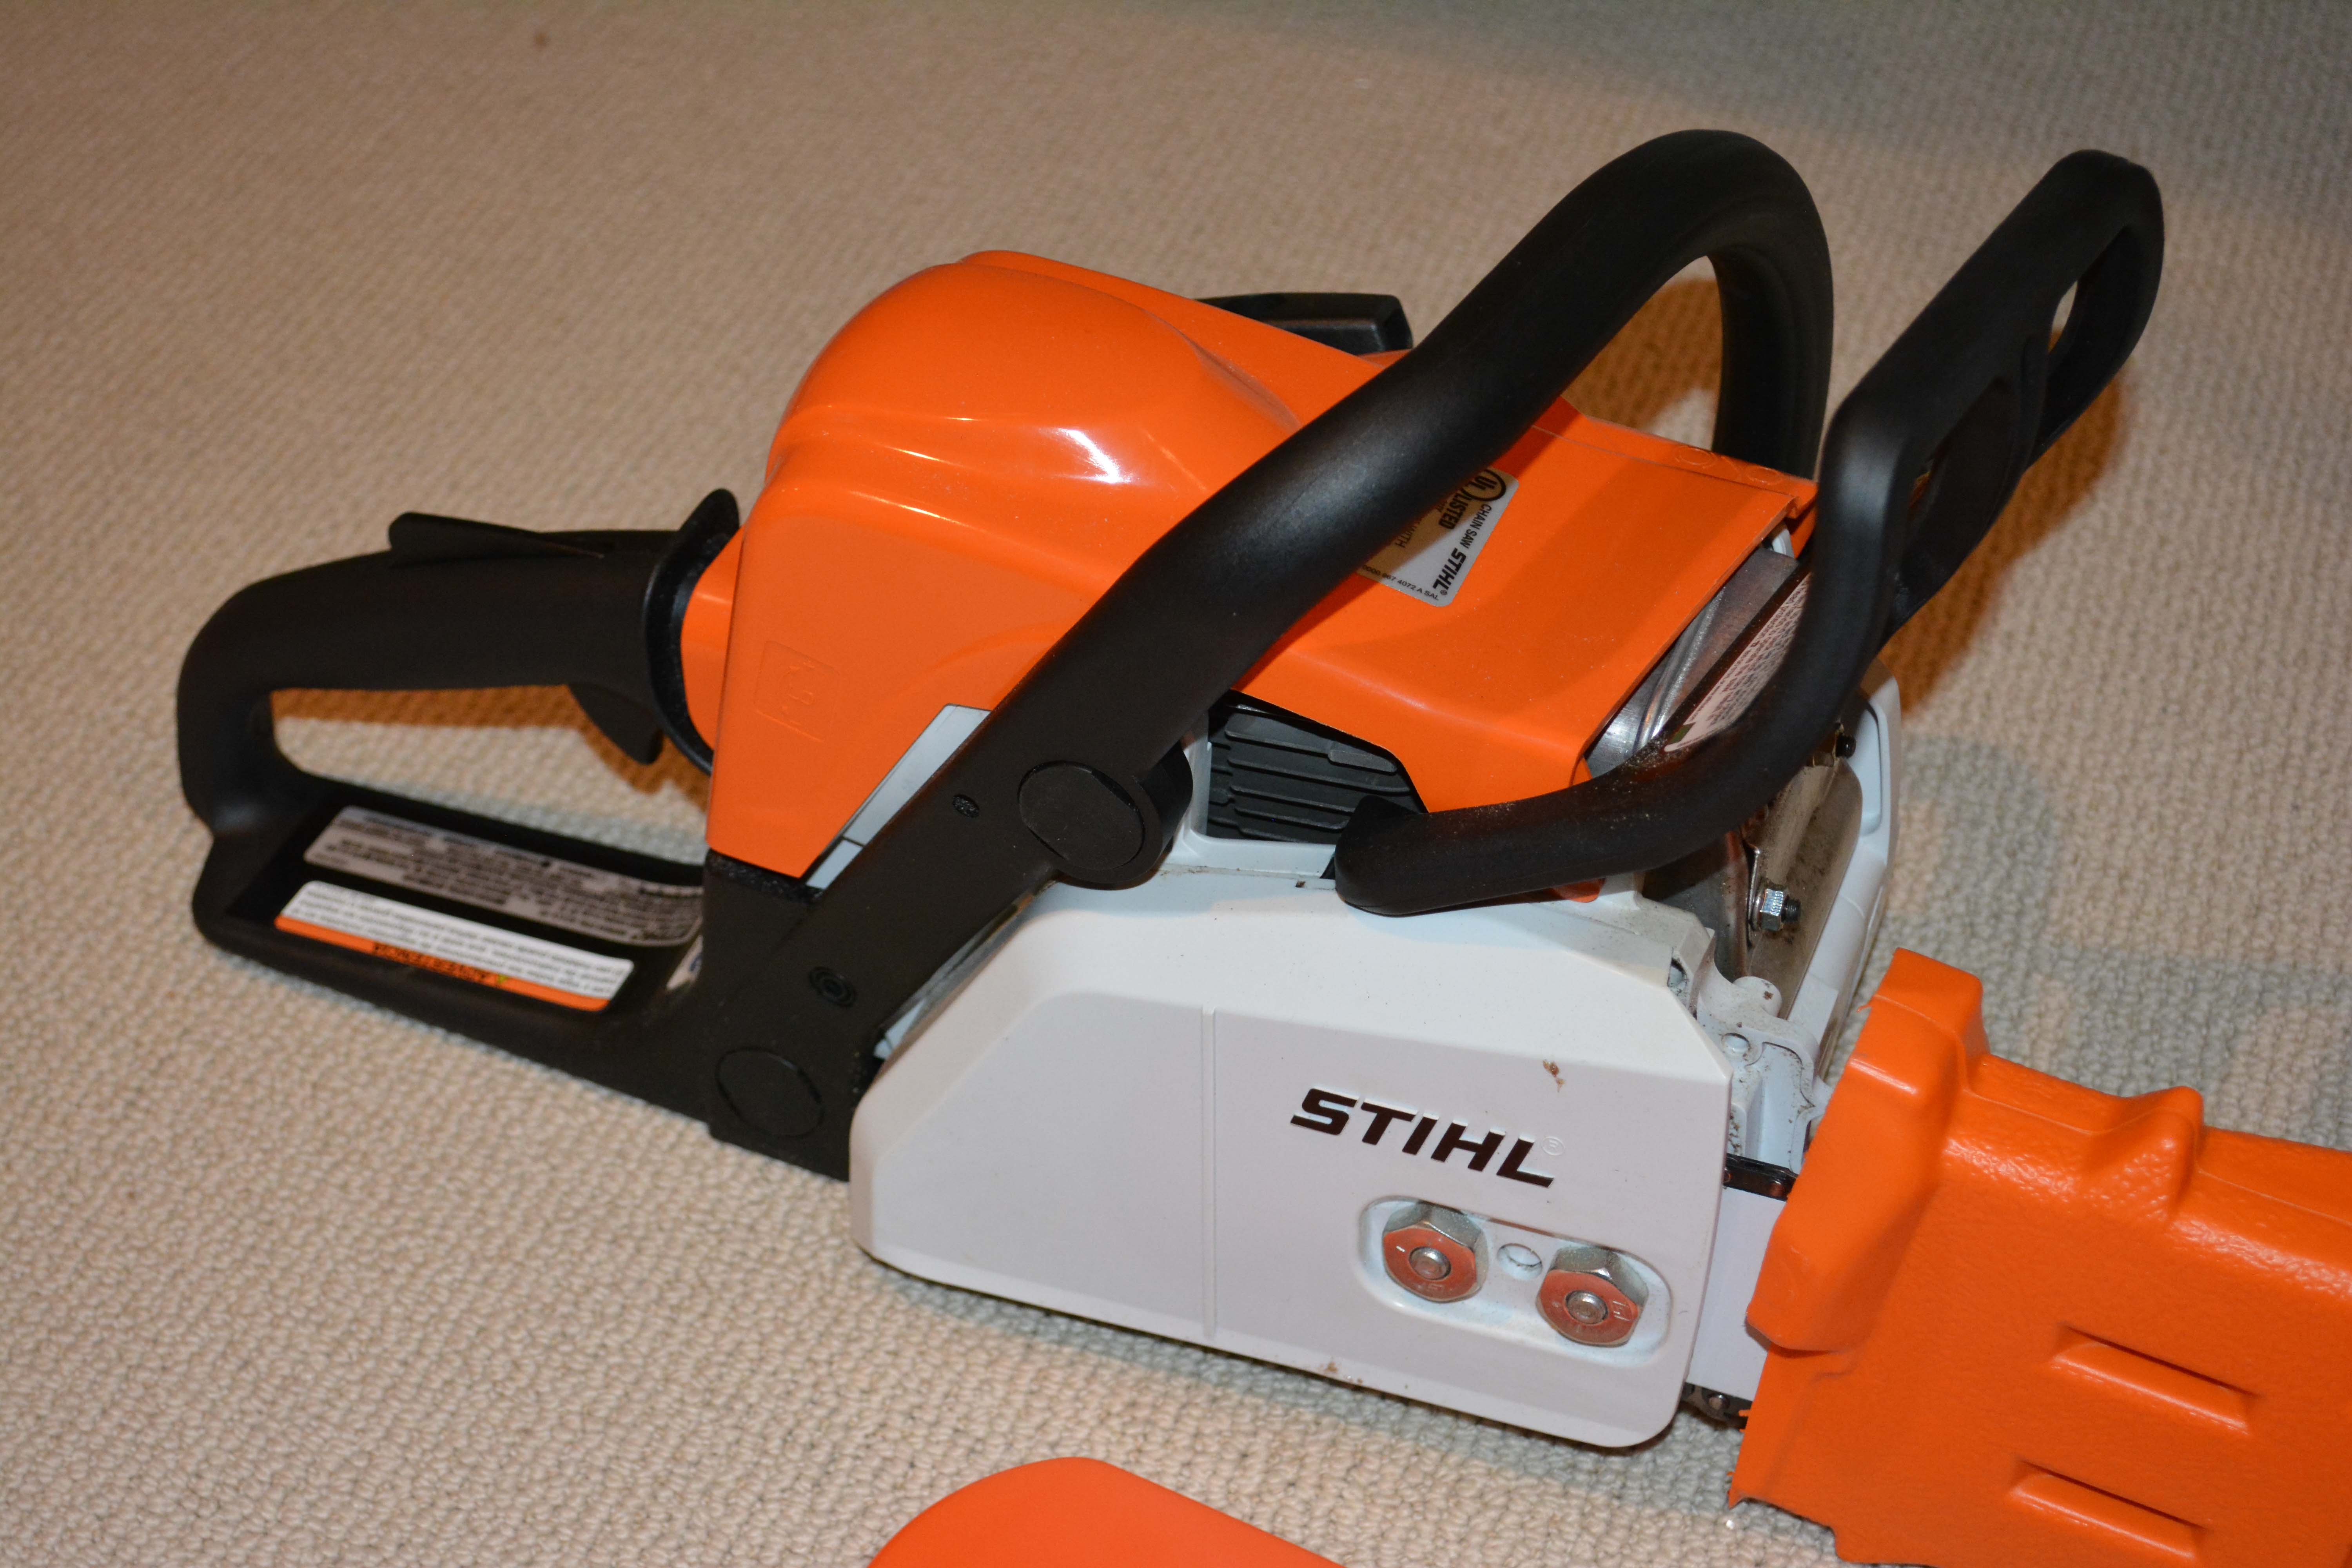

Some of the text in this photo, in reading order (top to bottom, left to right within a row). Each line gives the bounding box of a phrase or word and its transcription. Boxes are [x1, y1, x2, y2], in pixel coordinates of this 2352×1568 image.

[1438, 493, 1472, 530] LISTED
[1432, 503, 1492, 590] CHAIN SAW STIHL
[1397, 579, 1416, 590] 4072
[1424, 590, 1439, 601] SAL
[1290, 1085, 1555, 1189] STIHL
